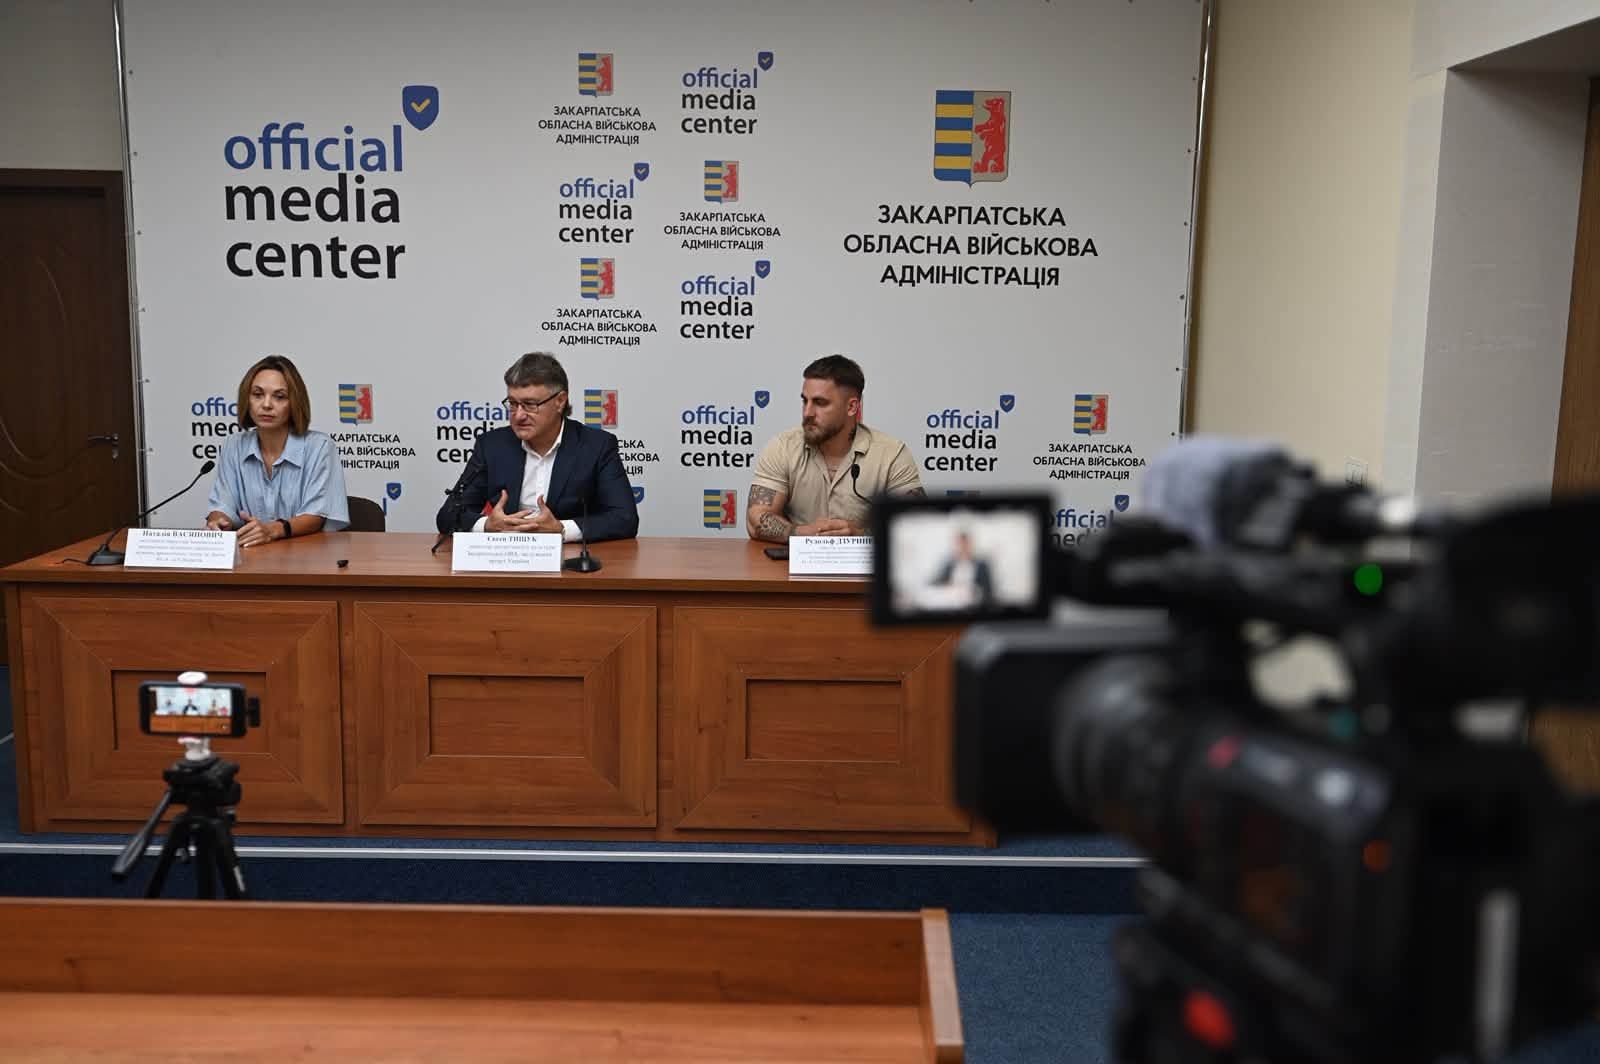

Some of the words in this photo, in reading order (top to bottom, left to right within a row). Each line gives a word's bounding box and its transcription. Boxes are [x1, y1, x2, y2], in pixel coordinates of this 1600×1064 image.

[683, 67, 757, 89] official
[682, 89, 755, 110] media
[554, 106, 640, 116] ЗАКАРПАТСЬКА
[539, 120, 593, 129] ОБЛАСНА
[596, 119, 656, 131] ВІЙСЬКОВА
[681, 116, 757, 134] center
[224, 122, 402, 172] official
[556, 134, 639, 146] АДМІНІСТРАЦІЯ
[559, 178, 634, 199] official
[225, 173, 400, 223] media
[560, 199, 632, 220] media
[680, 212, 765, 222] ЗАКАРПАТСЬКА
[878, 205, 1066, 226] ЗАКАРПАТСЬКА
[559, 225, 634, 243] center
[664, 226, 718, 235] ОБЛАСНА
[720, 224, 781, 236] ВІЙСЬКОВА
[681, 240, 763, 251] АДМІНІСТРАЦІЯ
[844, 234, 960, 254] ОБЛАСНА
[968, 233, 1098, 256] ВІЙСЬКОВА
[226, 236, 405, 279] center
[682, 275, 755, 295] official
[880, 265, 1059, 289] АДМІНІСТРАЦІЯ
[557, 309, 641, 319] ЗАКАРПАТСЬКА
[681, 296, 752, 316] media
[542, 322, 594, 331] ОБЛАСНА
[598, 321, 657, 332] ВІЙСЬКОВА
[680, 322, 754, 339] center
[559, 336, 640, 346] АДМІНІСТРАЦІЯ
[192, 397, 238, 416] offic
[682, 405, 754, 425] official
[927, 409, 999, 430] official
[330, 434, 400, 443] КАРПАТСЬКА
[682, 425, 752, 445] media
[926, 429, 996, 449] media
[357, 446, 416, 456] ВІЙСЬКОВА
[437, 448, 474, 462] cen
[1049, 444, 1132, 453] ЗАКАРПАТСЬКА
[341, 460, 399, 470] ІНІСТРАЦІЯ
[681, 450, 754, 467] center
[924, 454, 997, 471] center
[1033, 457, 1085, 466] ОБЛАСНА
[1088, 456, 1146, 466] ВІЙСЬКОВА
[1049, 470, 1129, 480] АДМІНІСТРАЦІЯ
[1050, 509, 1114, 528] fficial
